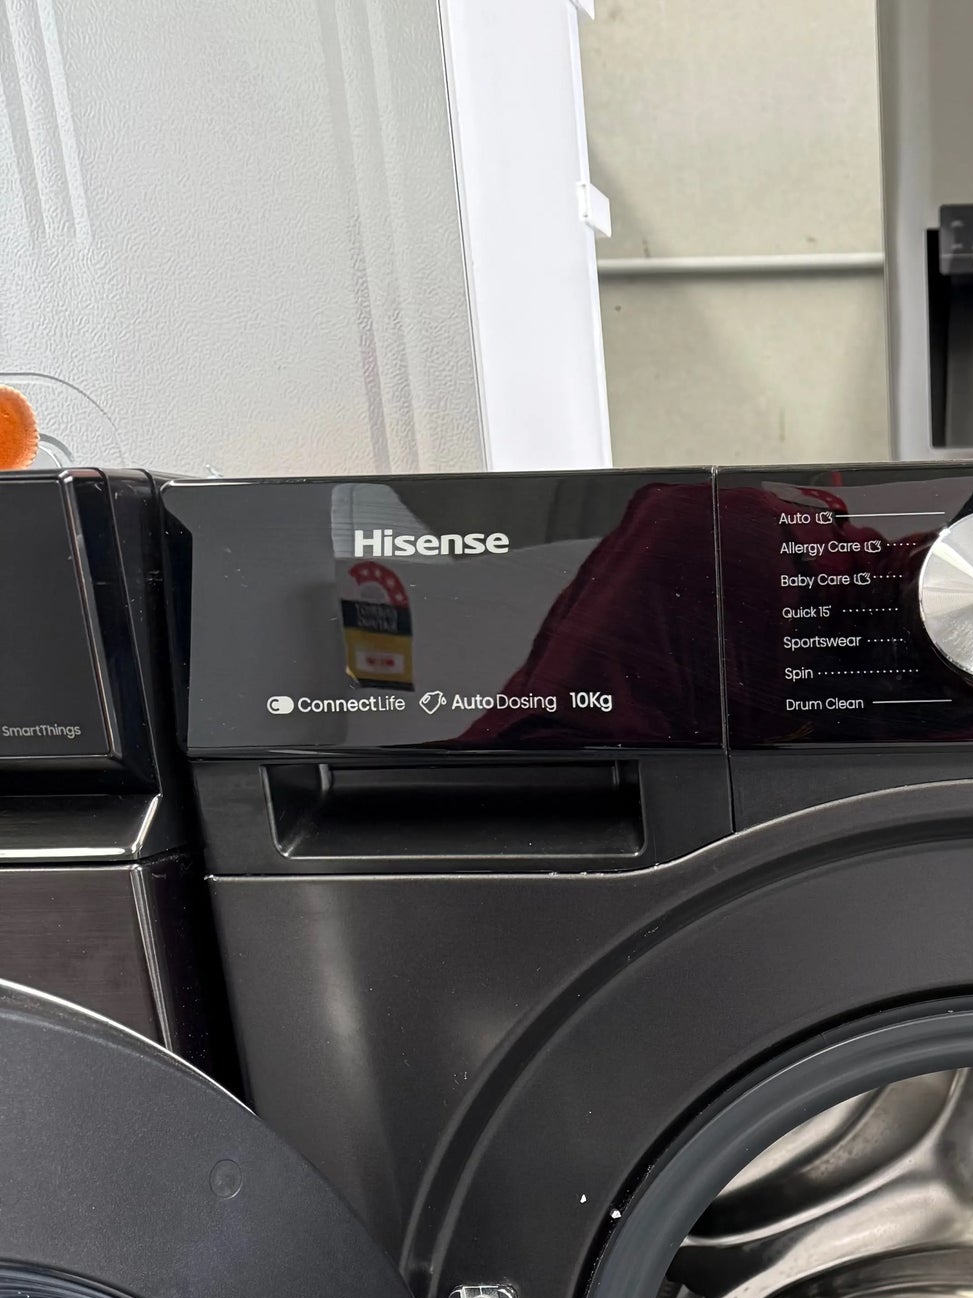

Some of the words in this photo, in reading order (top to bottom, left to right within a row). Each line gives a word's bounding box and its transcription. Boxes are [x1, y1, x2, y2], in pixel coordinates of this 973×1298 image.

[779, 513, 811, 524] Auto
[353, 529, 510, 557] Hisense
[780, 541, 825, 556] Allergy
[828, 541, 860, 552] Care
[781, 574, 814, 589] Baby
[818, 573, 850, 585] Care
[782, 606, 817, 618] Quick
[784, 636, 862, 651] Sportswear
[785, 667, 814, 682] Spin
[570, 692, 613, 711] 10Kg
[786, 699, 822, 710] Drum
[826, 698, 864, 709] Clean
[2, 724, 81, 739] SmartThings
